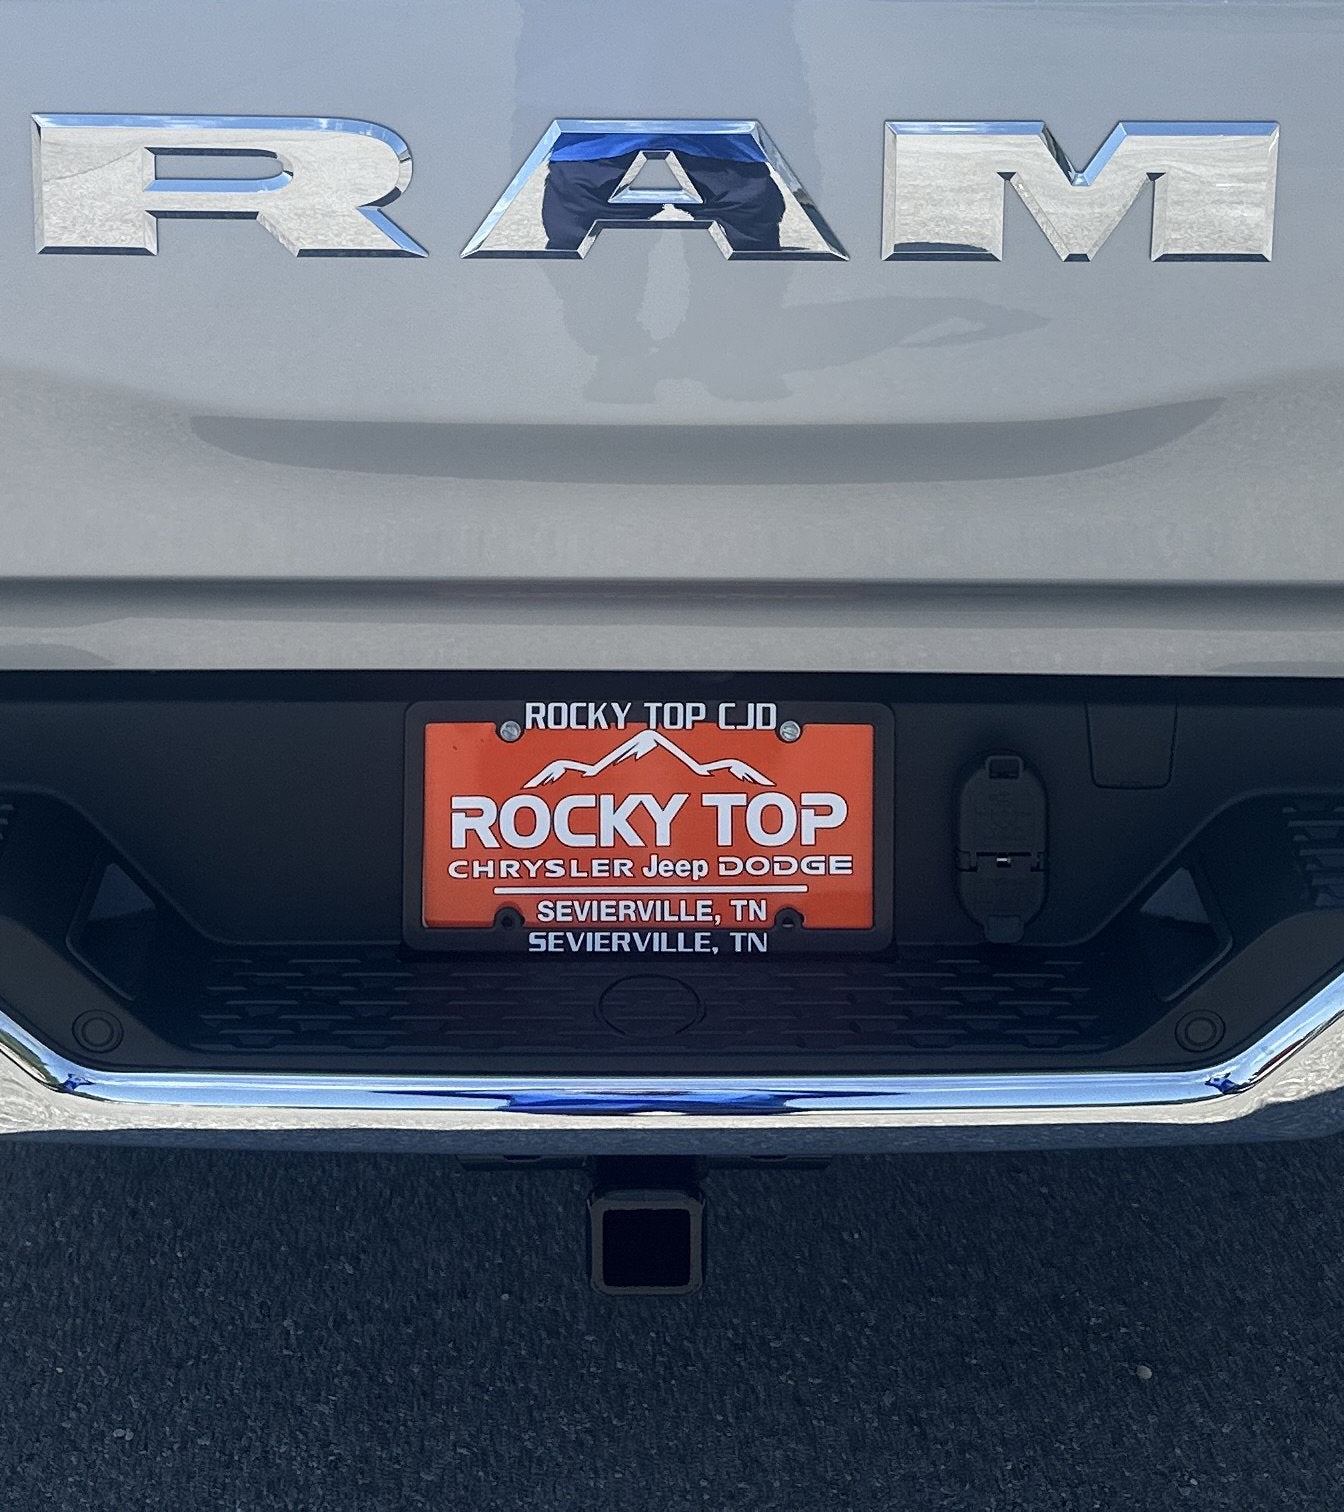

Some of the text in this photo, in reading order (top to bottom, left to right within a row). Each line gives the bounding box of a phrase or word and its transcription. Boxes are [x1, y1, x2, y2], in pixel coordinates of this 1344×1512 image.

[30, 113, 1279, 261] RAM
[524, 701, 777, 730] ROCKY TOP CJD
[450, 791, 850, 849] ROCKY TOP
[448, 854, 853, 881] CHRYSLER Jeep DODGE
[537, 899, 767, 925] SEVIERVILLE, TN
[528, 931, 768, 955] SEVIERVILLE, TN
